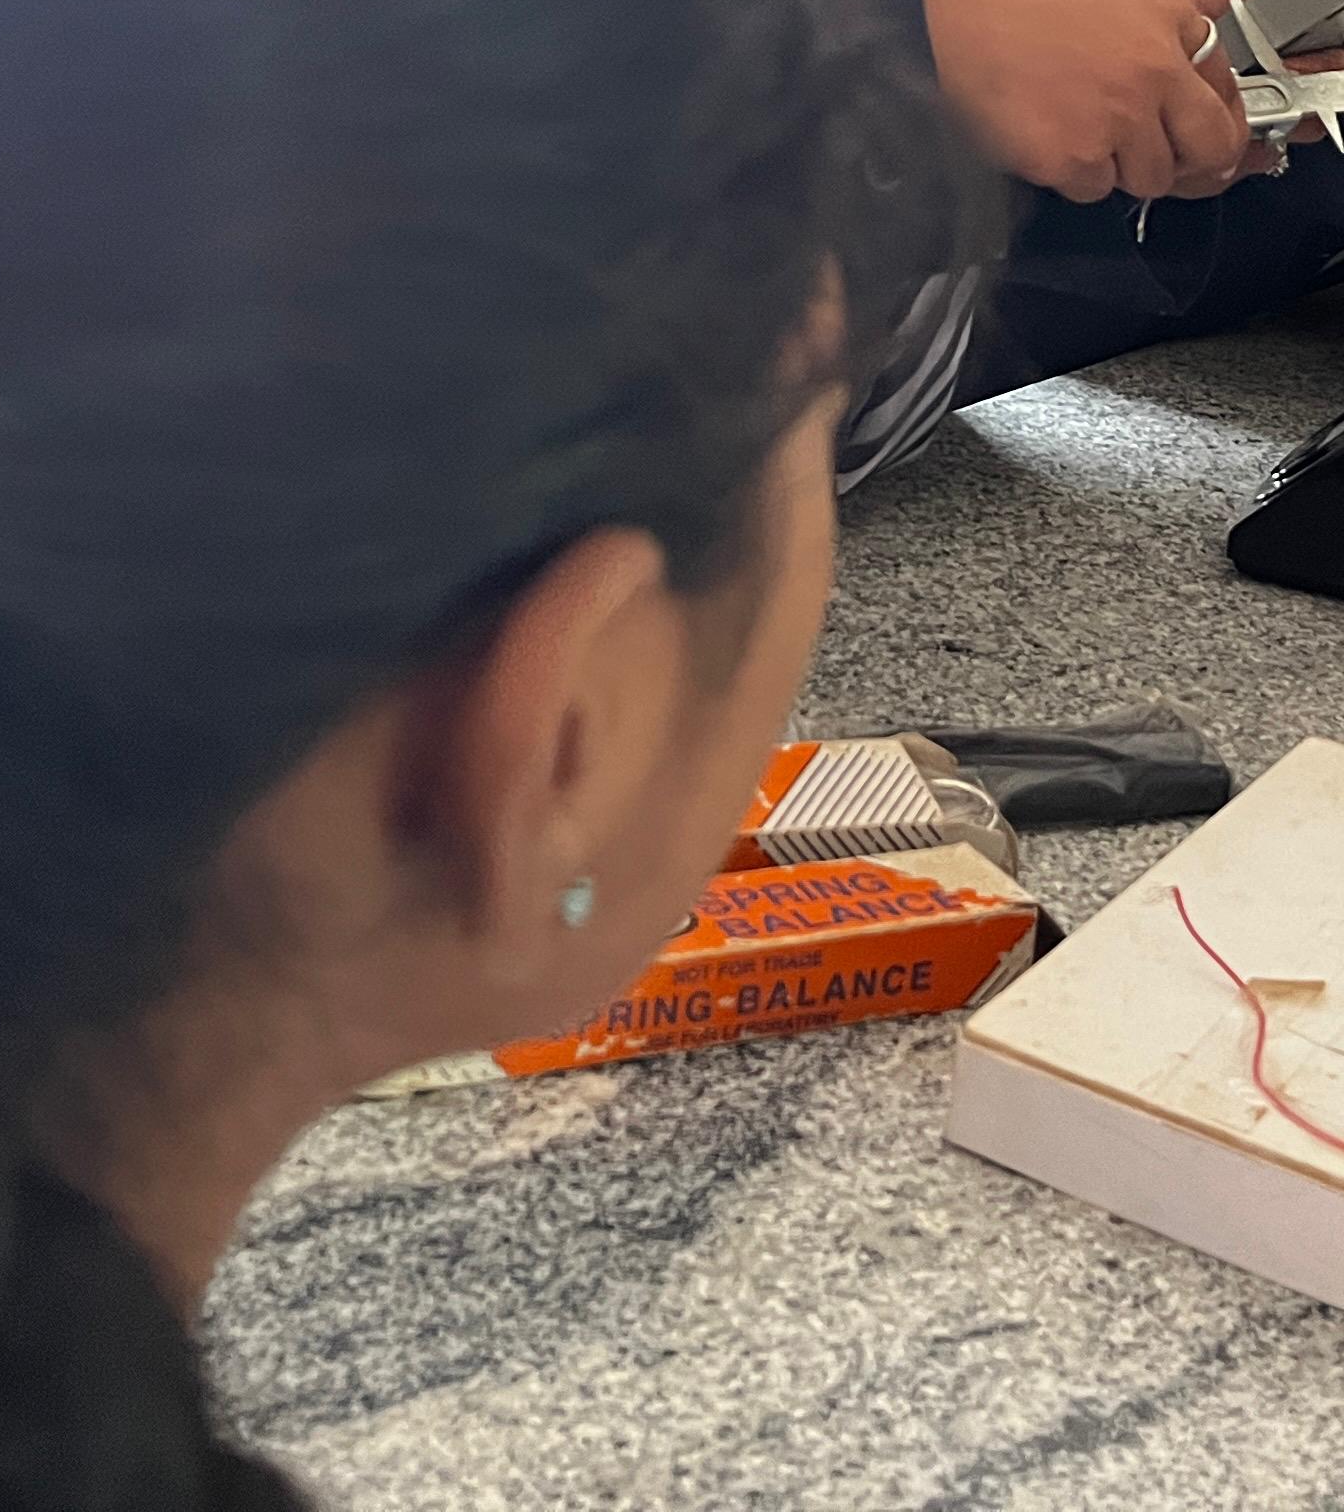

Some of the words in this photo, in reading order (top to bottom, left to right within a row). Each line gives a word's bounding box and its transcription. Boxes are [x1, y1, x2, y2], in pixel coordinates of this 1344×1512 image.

[695, 871, 892, 916] SPRING
[717, 890, 966, 938] BALANCE
[672, 964, 709, 985] NOT
[716, 959, 755, 981] FOR
[765, 949, 823, 972] TRADE
[594, 990, 713, 1034] RING
[736, 960, 934, 1016] BALANCE
